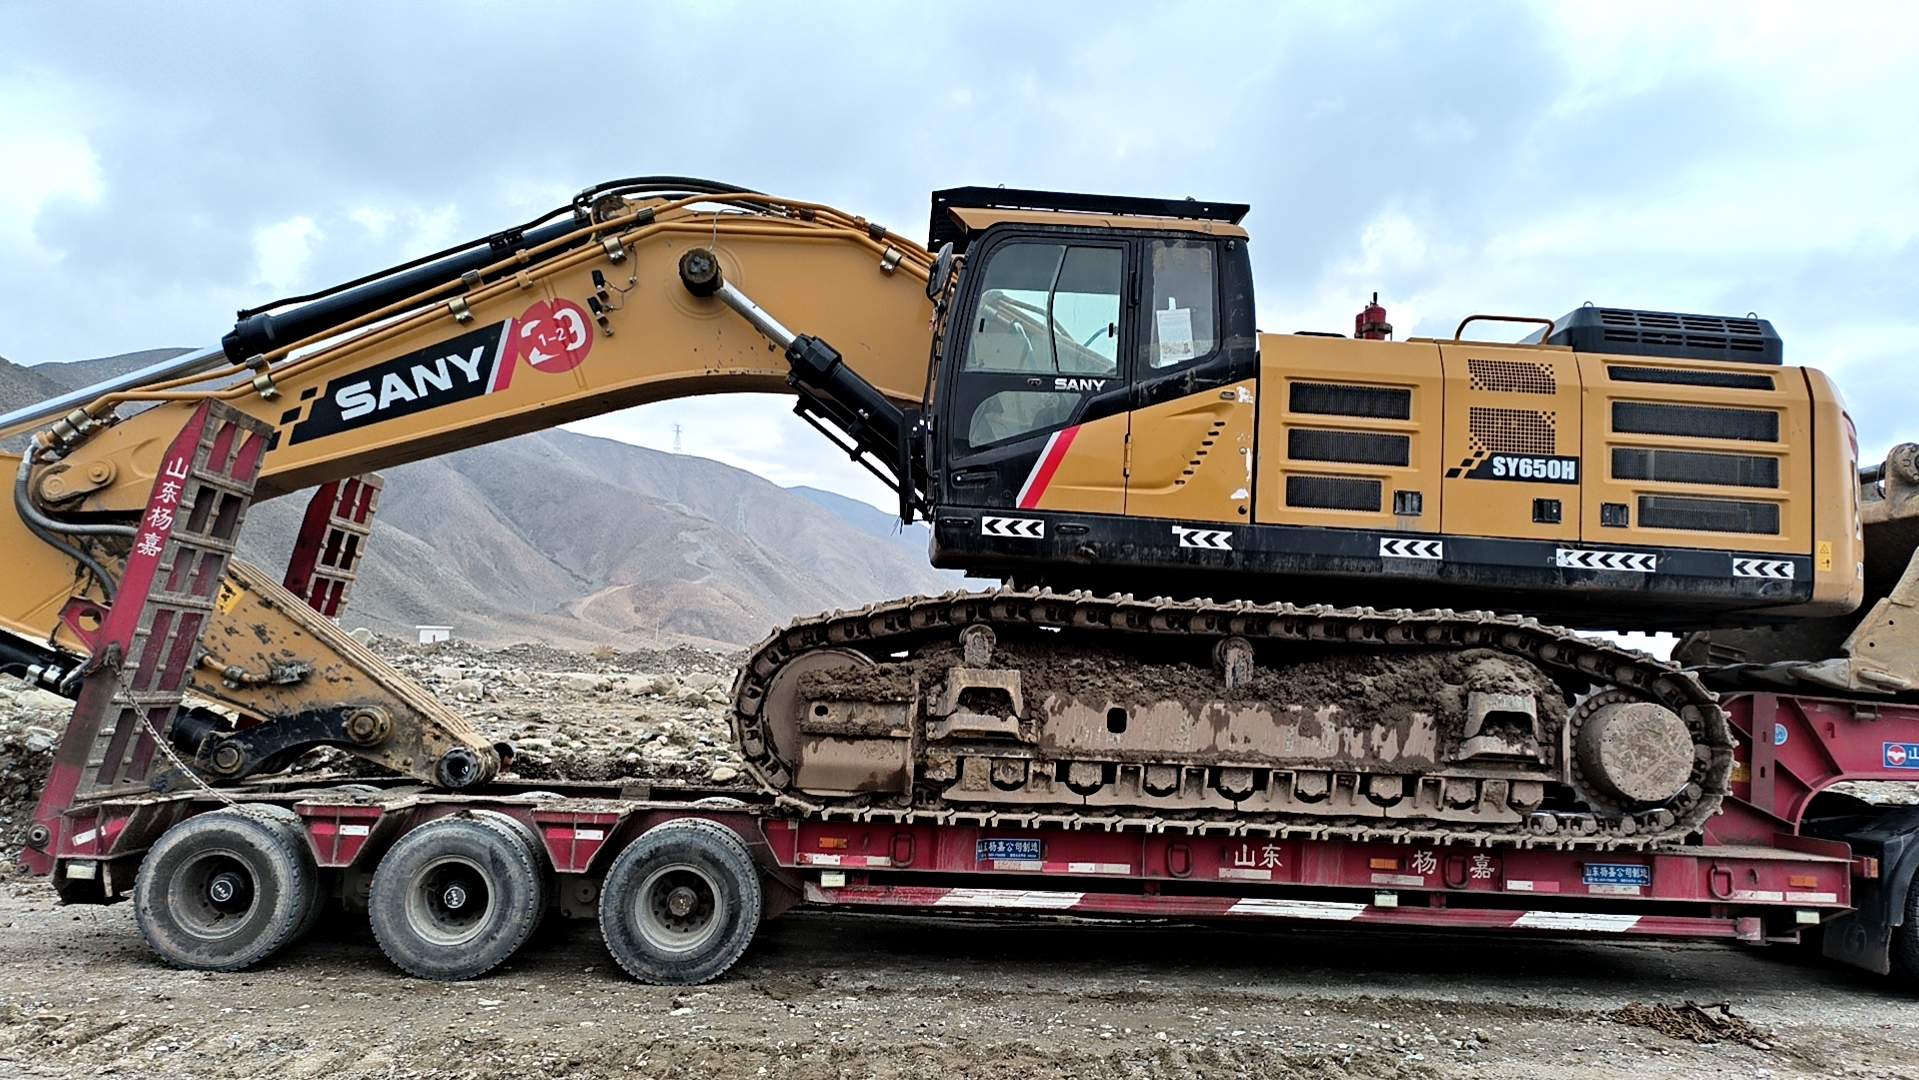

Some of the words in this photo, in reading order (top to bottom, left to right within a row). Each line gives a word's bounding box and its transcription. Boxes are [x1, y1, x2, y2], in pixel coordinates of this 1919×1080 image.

[538, 328, 567, 346] 1-2
[335, 346, 484, 420] SANY
[1054, 378, 1106, 391] SANY
[1492, 456, 1576, 480] SY650H
